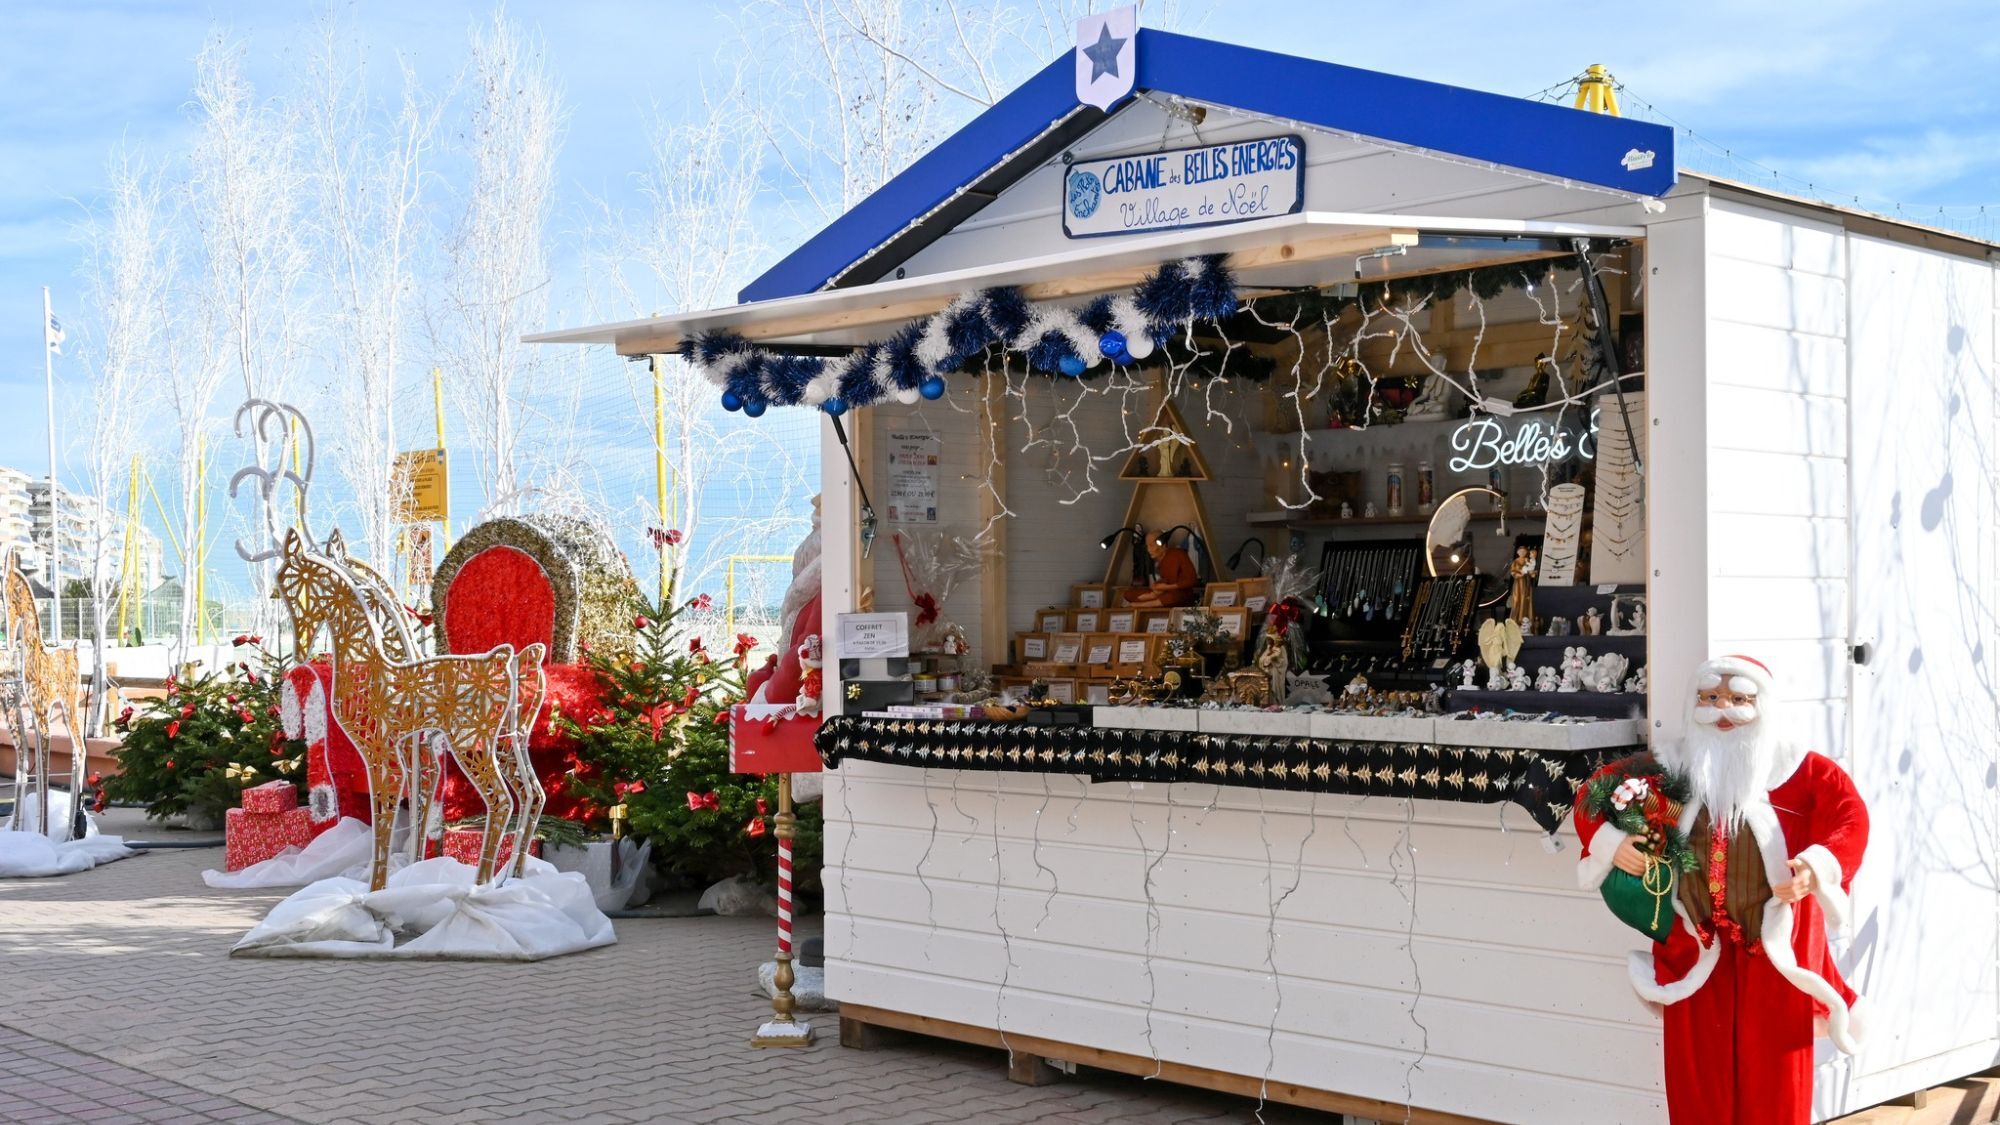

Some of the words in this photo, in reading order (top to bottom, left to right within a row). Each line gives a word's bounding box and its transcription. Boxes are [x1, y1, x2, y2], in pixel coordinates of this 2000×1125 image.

[1103, 156, 1167, 194] CABANE
[1169, 168, 1181, 184] des
[1184, 146, 1229, 185] BELLES
[1119, 197, 1190, 228] Village
[1198, 195, 1214, 216] de
[1221, 182, 1269, 215] Noël
[1449, 417, 1571, 472] Belle's
